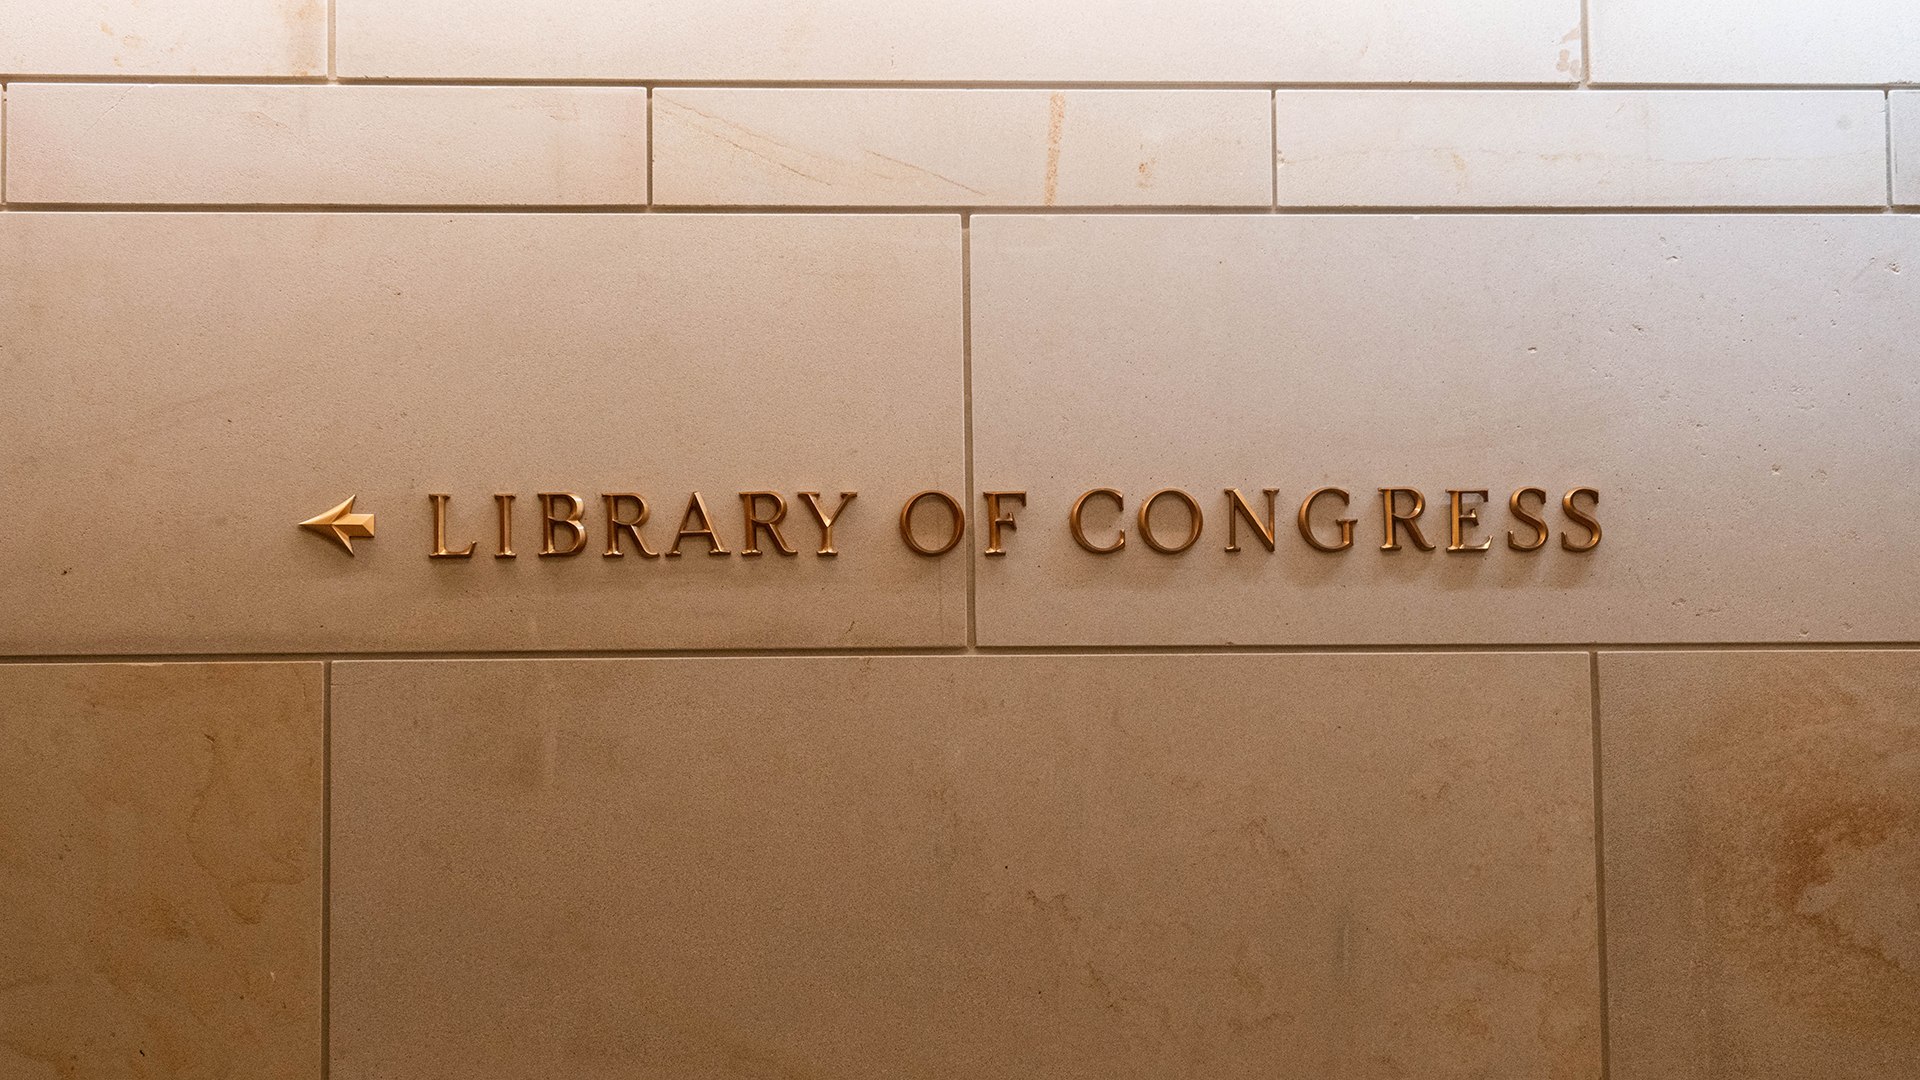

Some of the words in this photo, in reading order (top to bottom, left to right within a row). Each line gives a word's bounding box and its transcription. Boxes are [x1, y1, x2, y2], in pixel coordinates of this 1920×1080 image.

[428, 491, 858, 559] LIBRARY
[899, 490, 1027, 556] OF
[1069, 487, 1603, 555] CONGRESS
